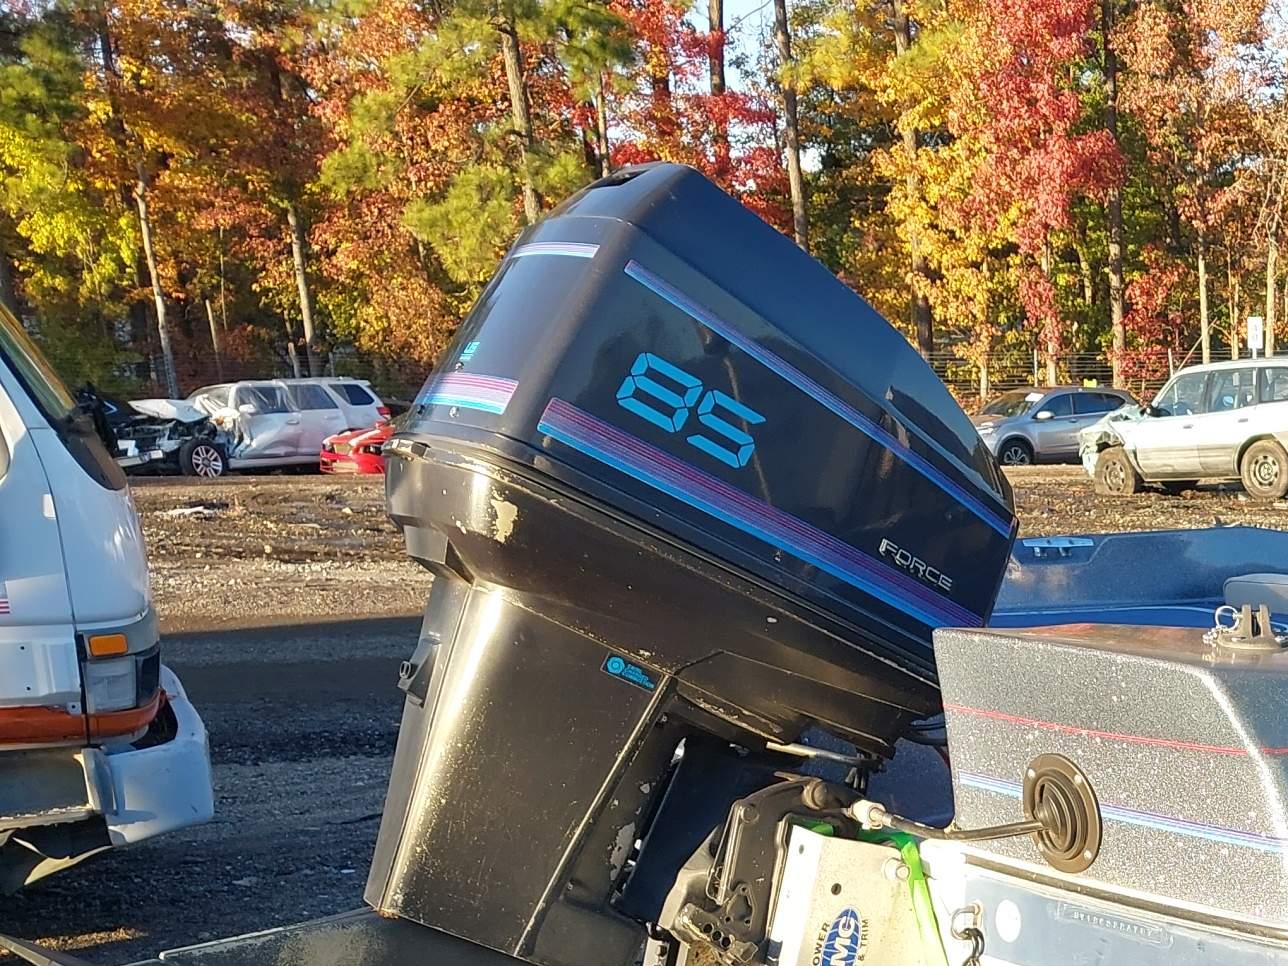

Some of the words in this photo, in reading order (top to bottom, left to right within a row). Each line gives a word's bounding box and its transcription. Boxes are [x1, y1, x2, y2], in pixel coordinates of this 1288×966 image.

[616, 352, 767, 469] 85
[878, 538, 953, 591] FORCE
[860, 919, 869, 948] TRIM
[858, 954, 866, 962] &
